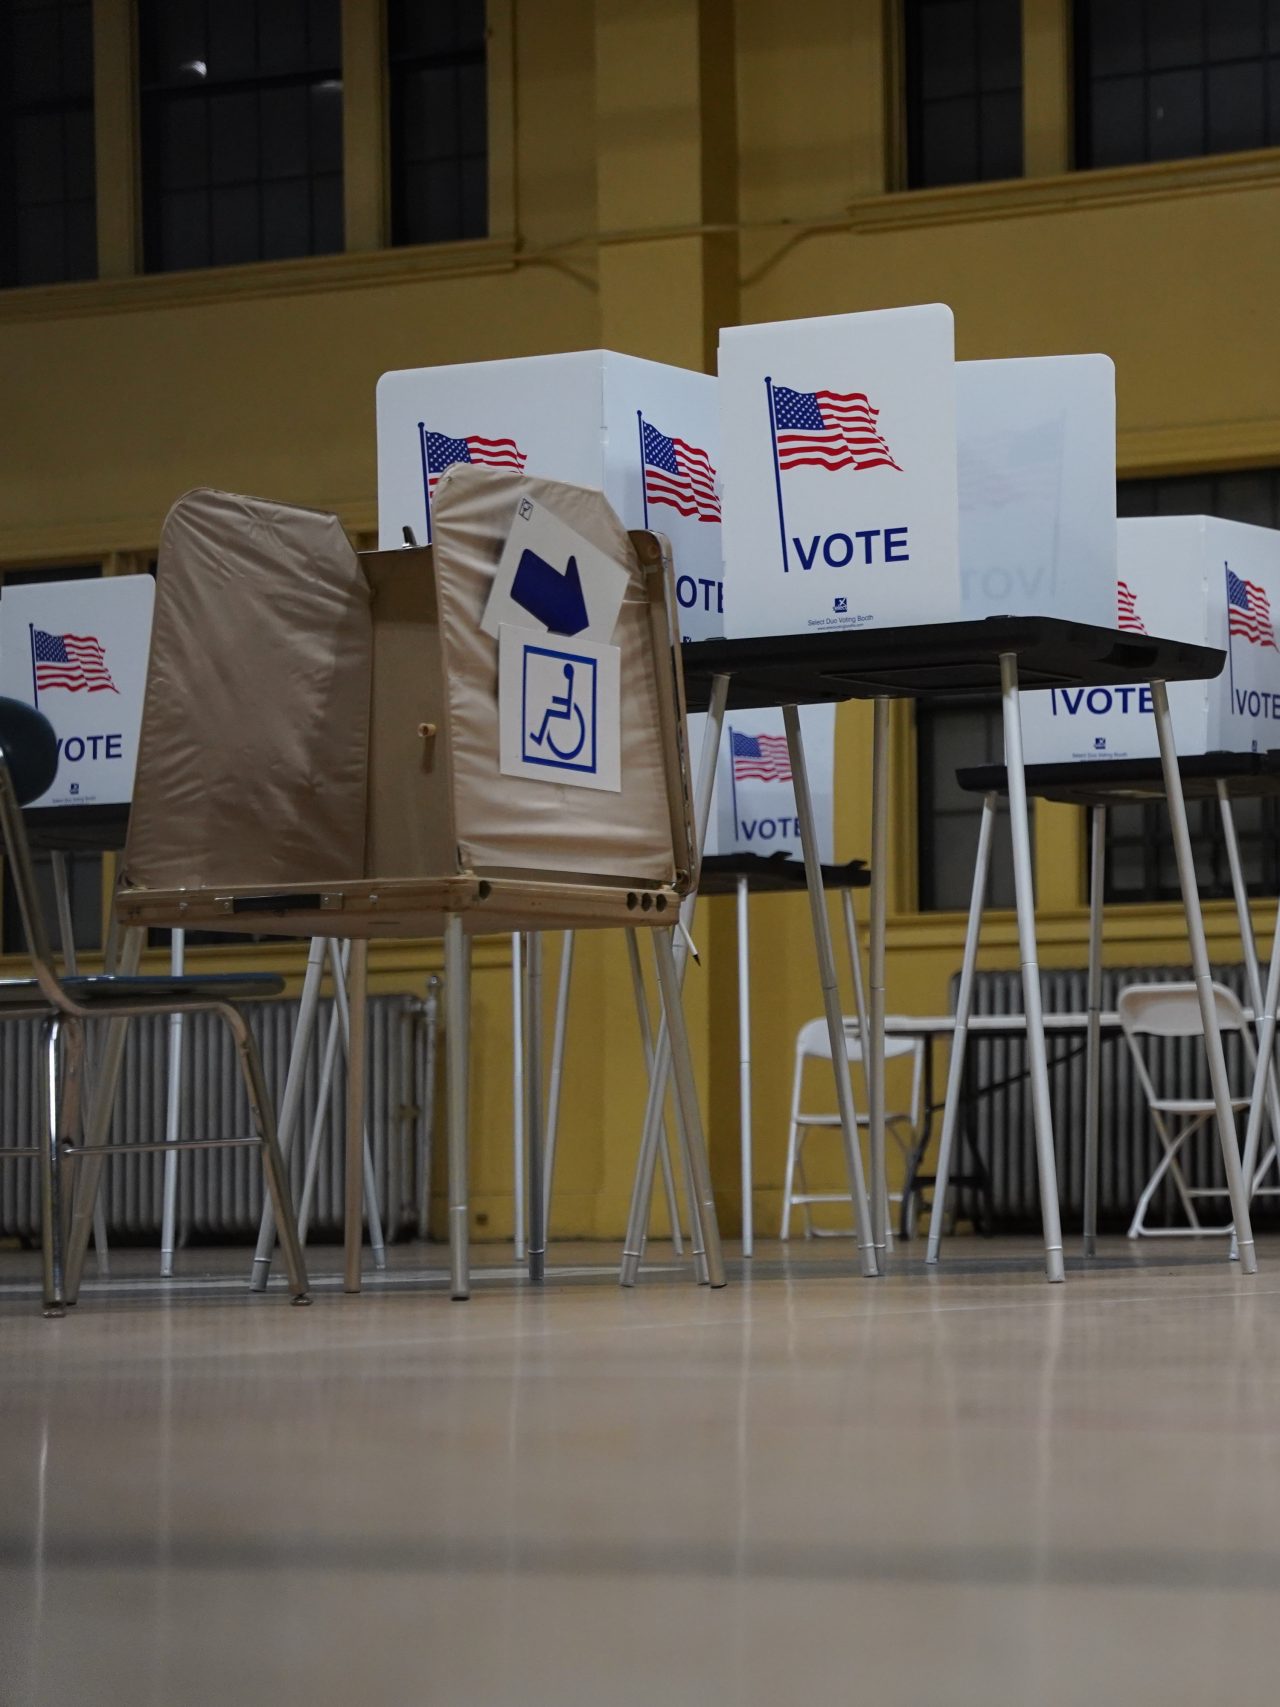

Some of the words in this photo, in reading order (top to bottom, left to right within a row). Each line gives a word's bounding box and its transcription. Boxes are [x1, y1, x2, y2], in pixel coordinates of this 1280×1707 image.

[792, 526, 910, 571] VOTE
[676, 574, 723, 613] OT
[808, 618, 825, 626] Select
[826, 617, 837, 625] Duo
[838, 616, 856, 624] Voting
[857, 614, 874, 622] Booth
[1061, 687, 1155, 715] VOTE
